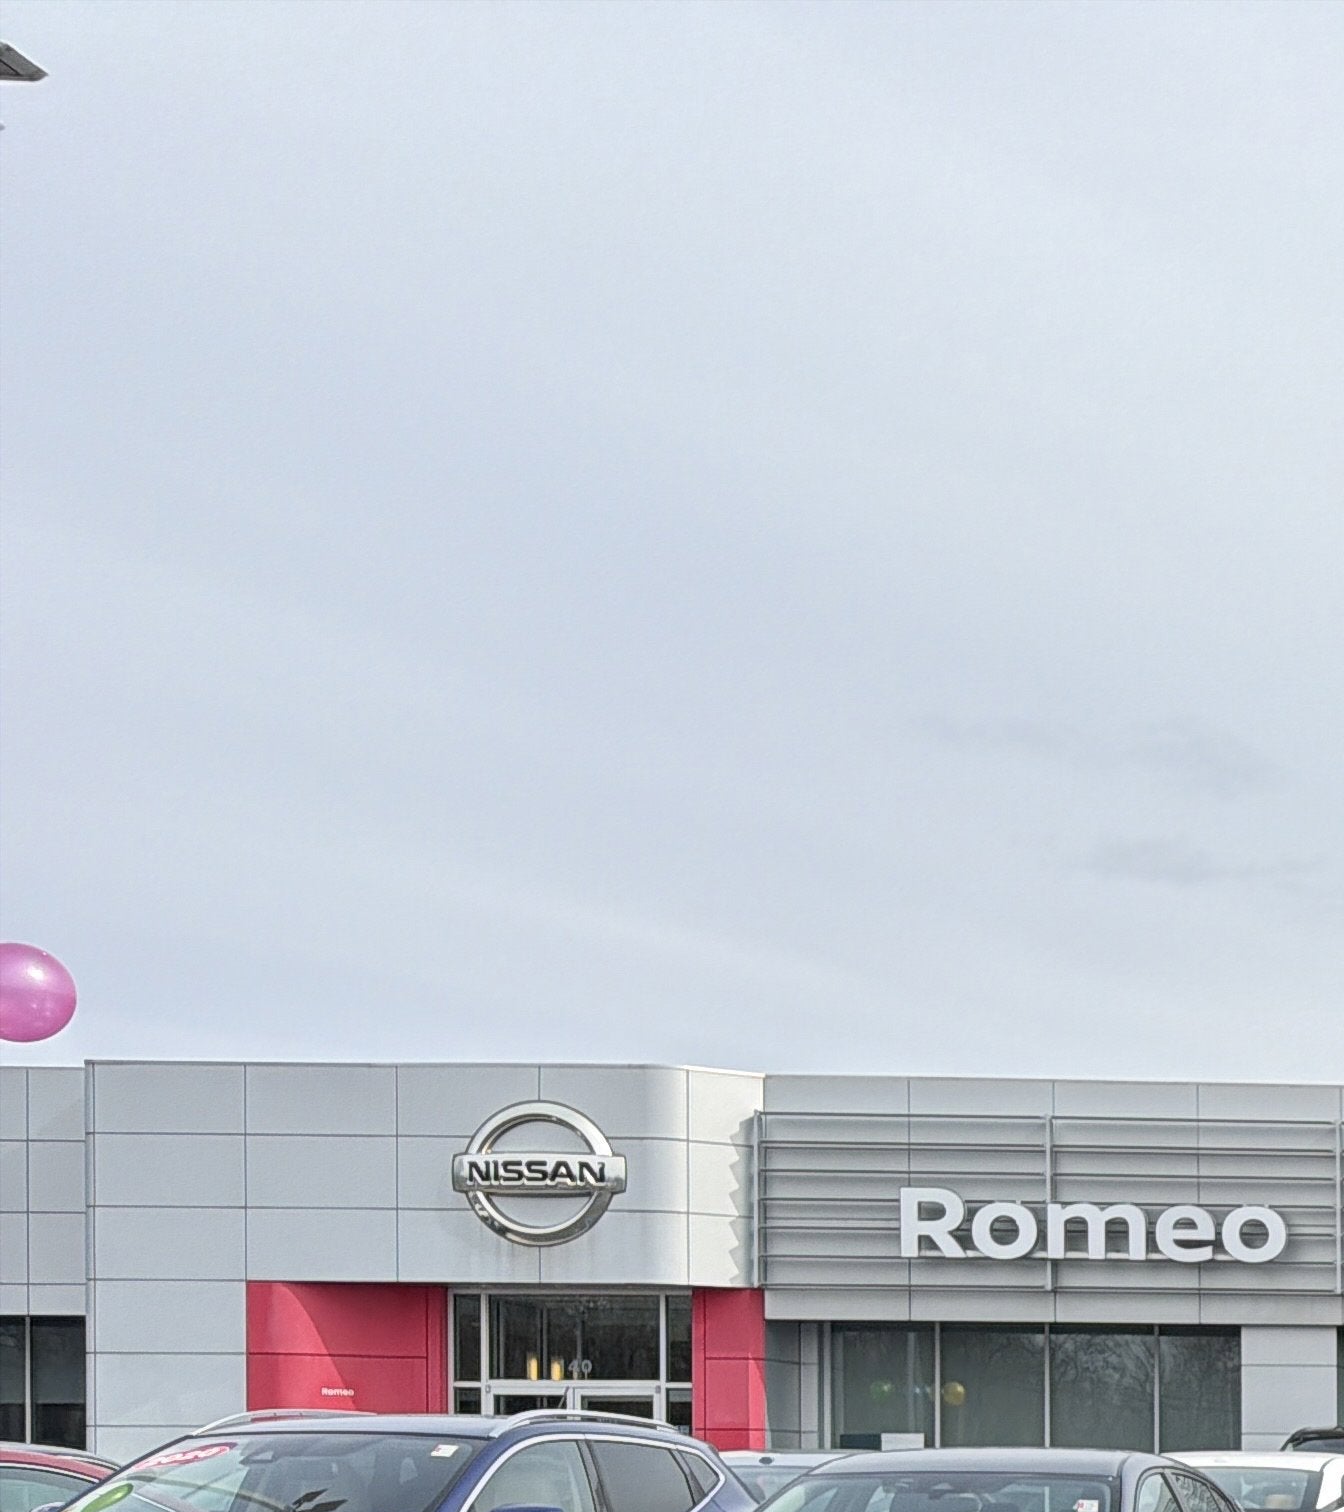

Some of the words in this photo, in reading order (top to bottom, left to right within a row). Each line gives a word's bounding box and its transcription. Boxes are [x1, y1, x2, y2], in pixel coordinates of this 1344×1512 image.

[467, 1160, 606, 1184] NISSAN
[899, 1186, 1288, 1263] Romeo
[321, 1387, 355, 1397] Romeo
